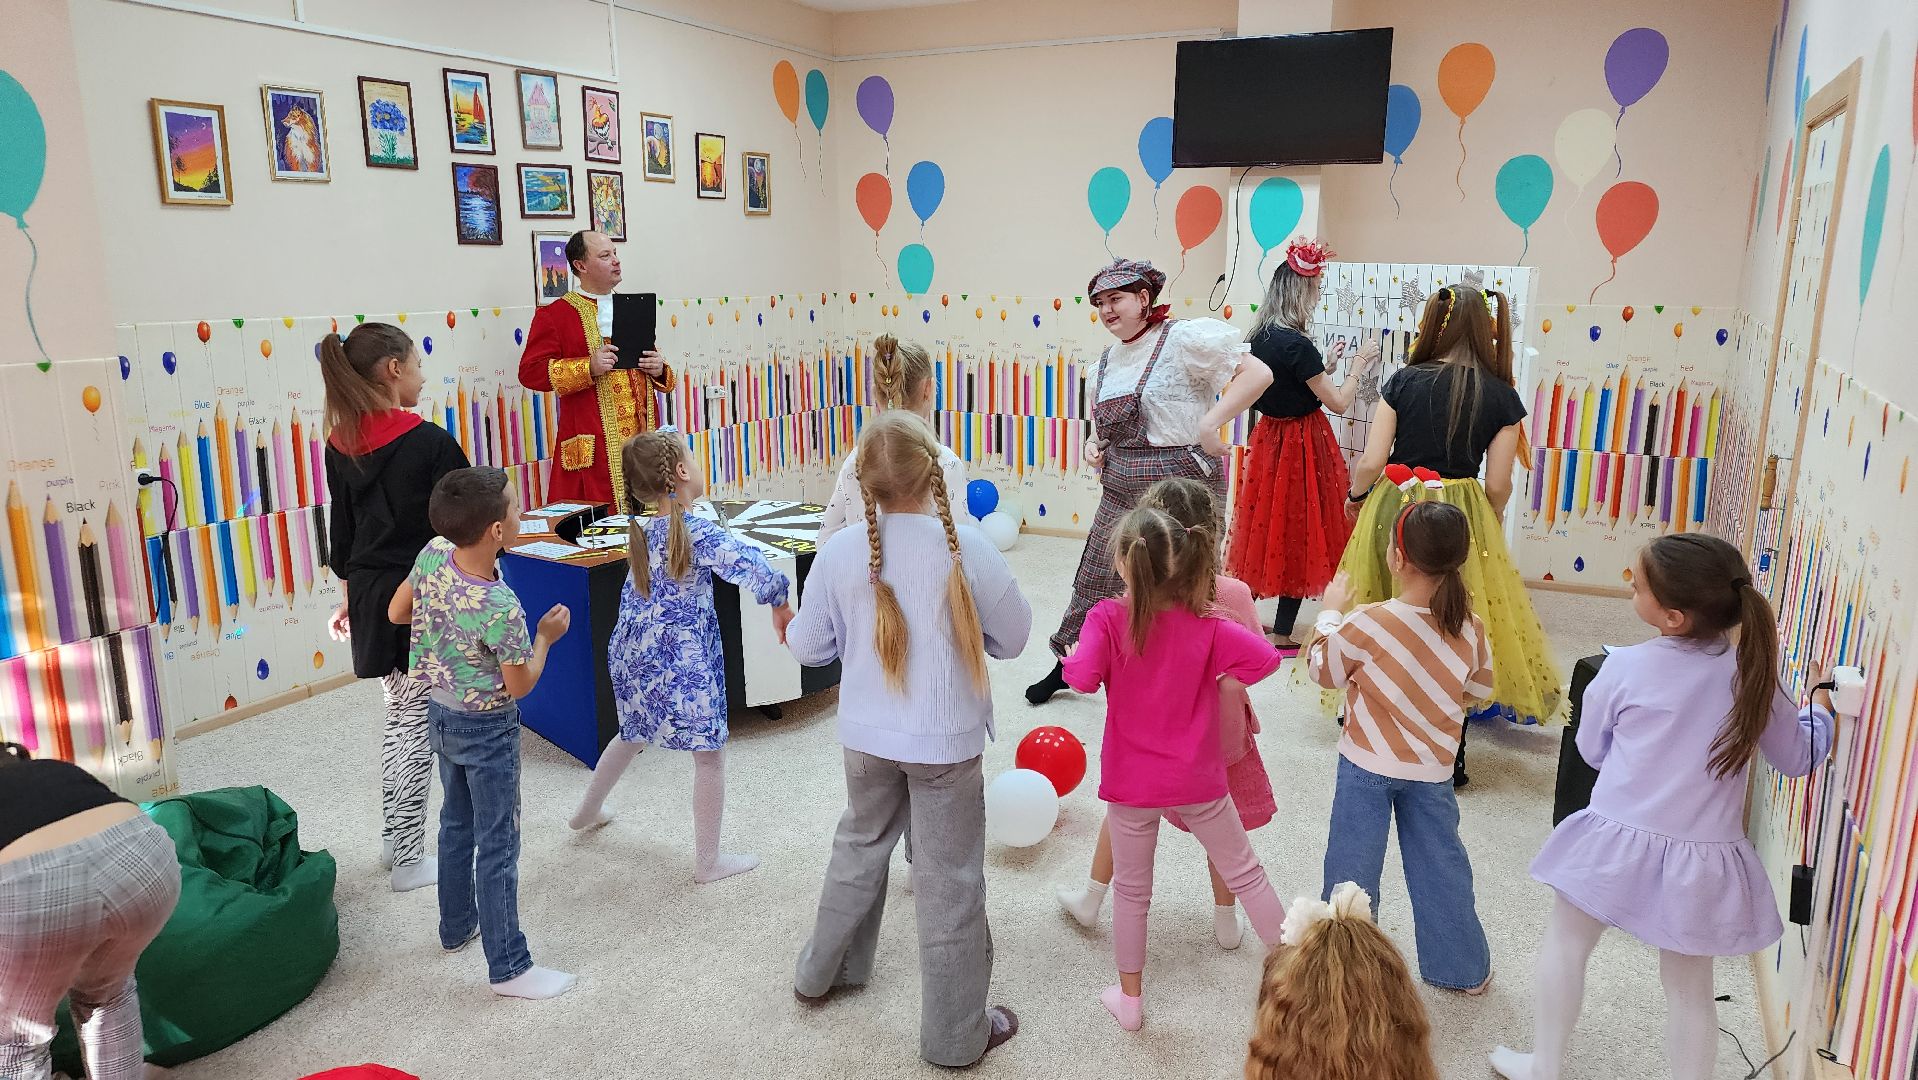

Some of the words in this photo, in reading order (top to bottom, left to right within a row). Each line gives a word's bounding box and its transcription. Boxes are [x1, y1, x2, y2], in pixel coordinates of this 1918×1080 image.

[1680, 364, 1694, 372] Red
[1649, 380, 1666, 388] Black
[217, 386, 245, 397] Orange
[194, 400, 211, 410] Blue
[248, 416, 267, 426] Black
[45, 476, 75, 489] purple
[66, 498, 97, 514] Black
[225, 632, 242, 641] Blue
[117, 749, 144, 767] Black
[135, 769, 161, 785] purple
